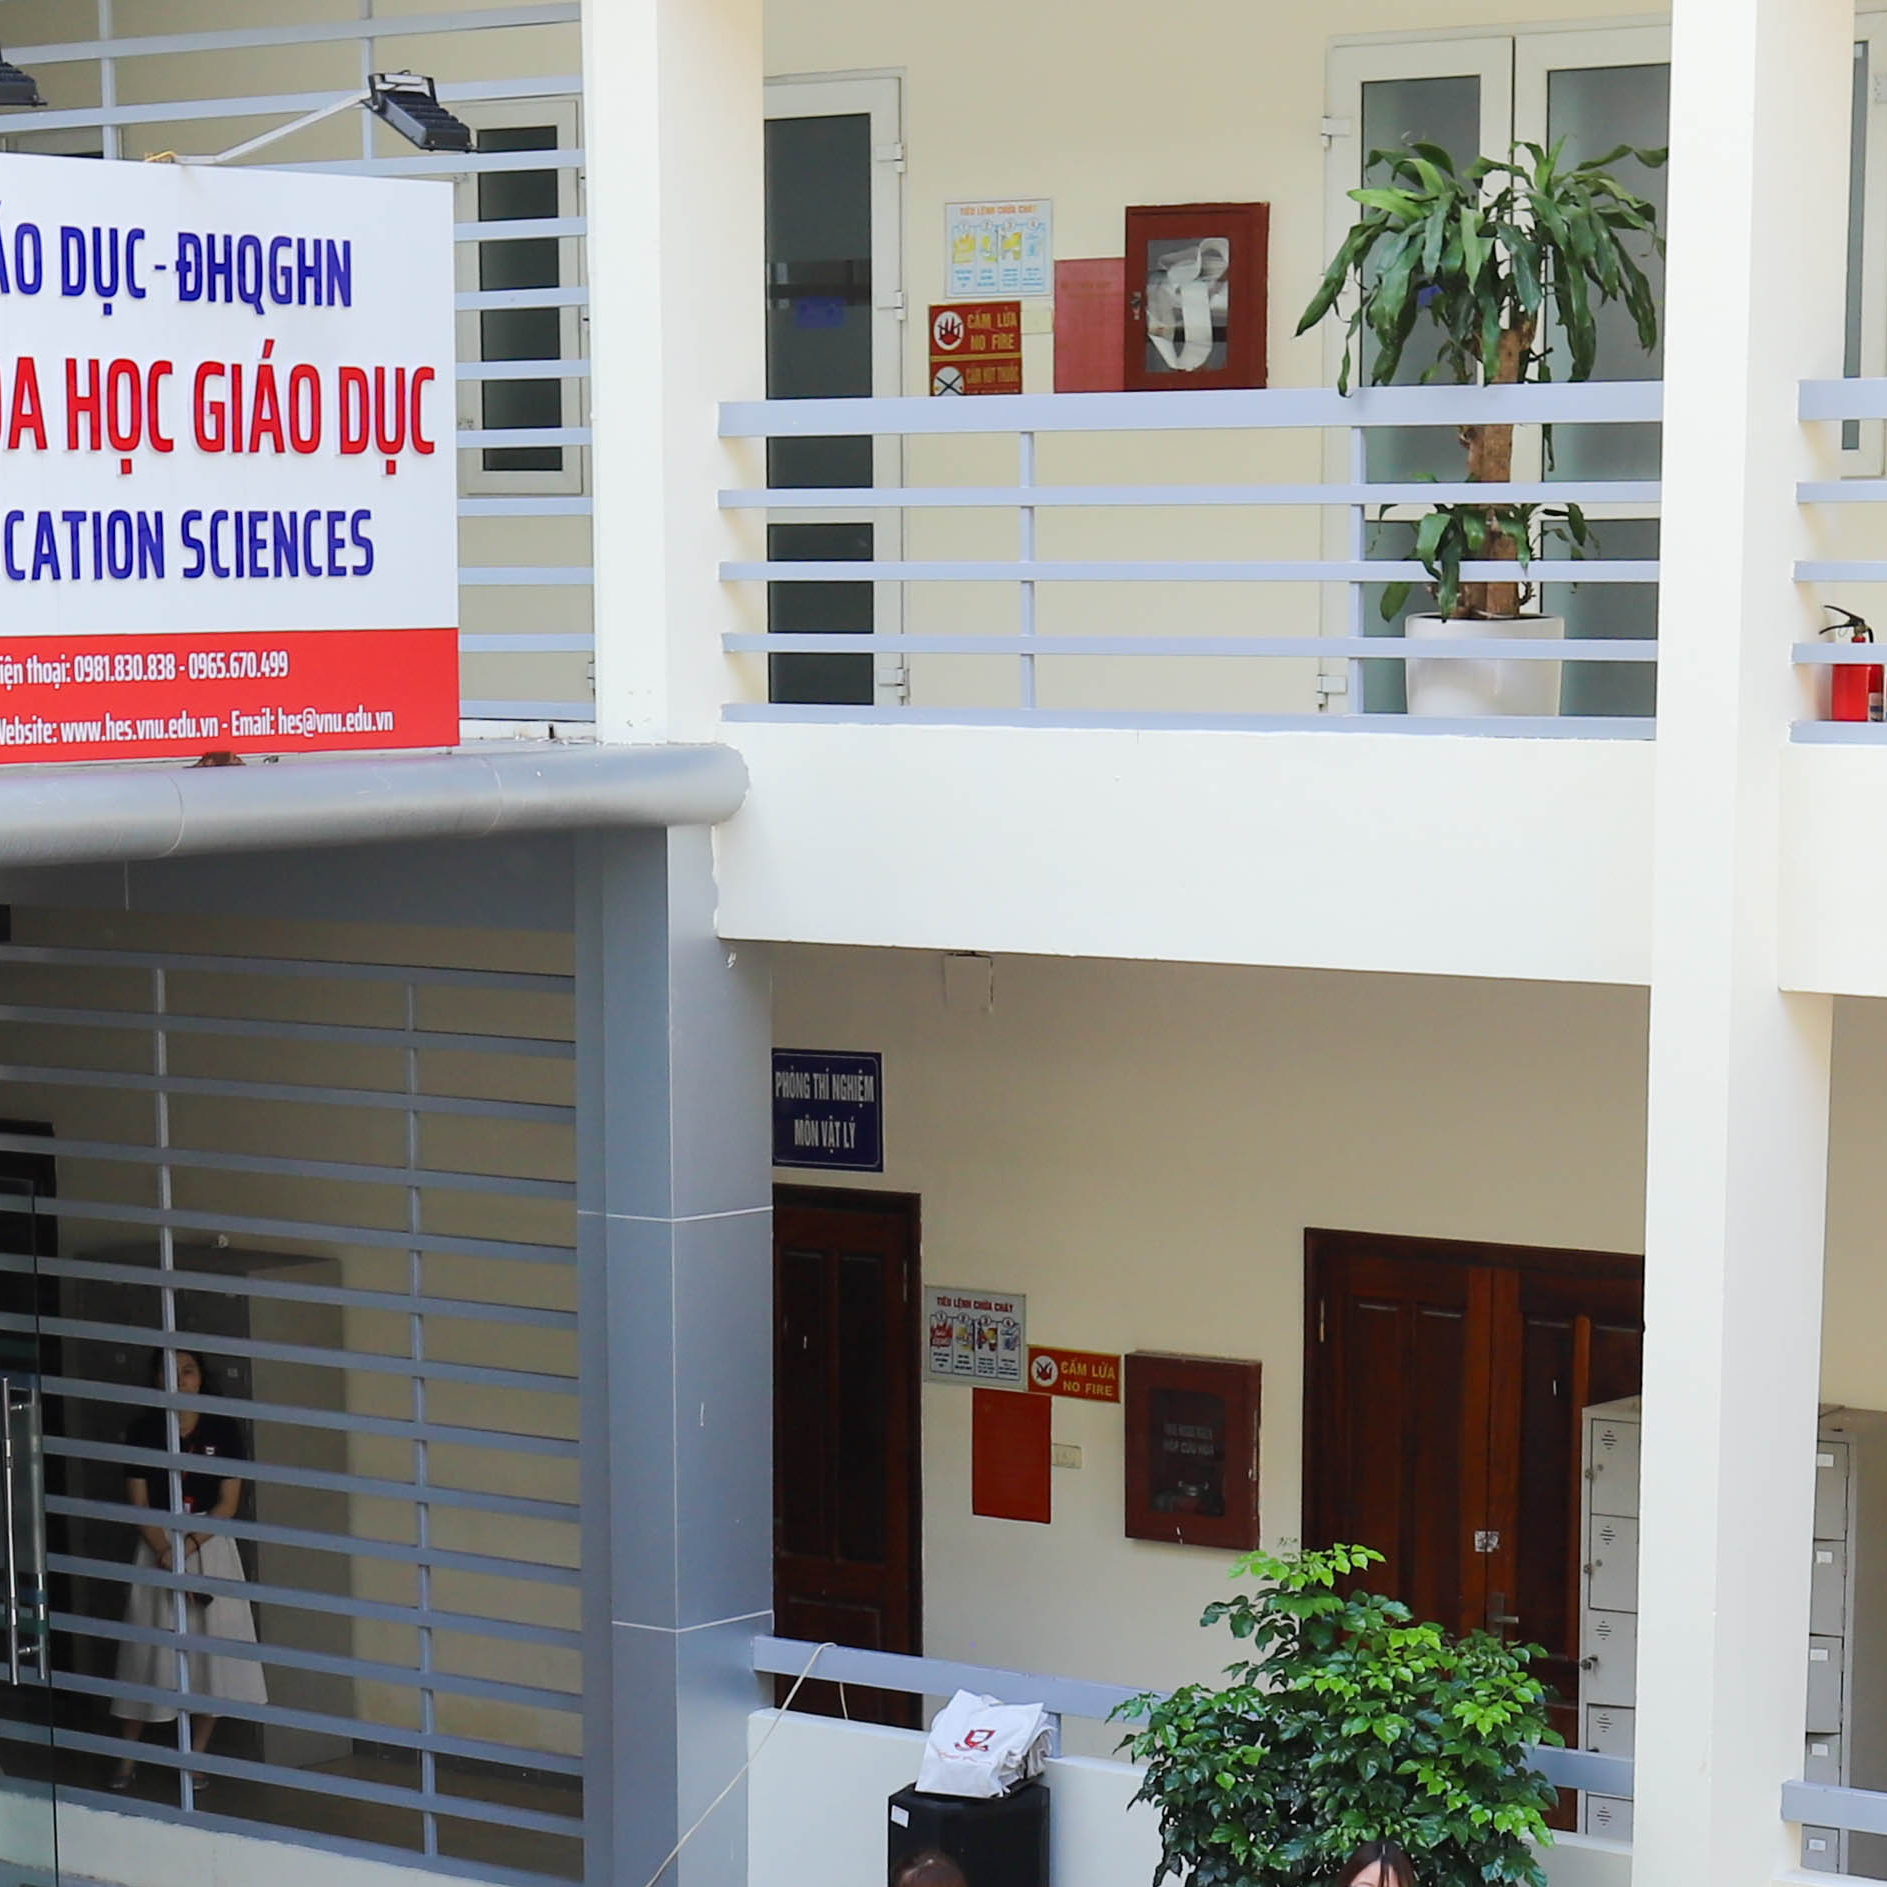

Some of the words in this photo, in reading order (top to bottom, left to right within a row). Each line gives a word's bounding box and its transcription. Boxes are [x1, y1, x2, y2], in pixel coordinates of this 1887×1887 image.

[61, 225, 146, 316] DỤC
[176, 231, 352, 315] ĐHQGHN
[970, 335, 986, 350] NO
[992, 334, 1015, 350] FIRE
[65, 357, 175, 476] HỌC
[193, 338, 322, 455] GIÁO
[338, 365, 436, 476] DỤC
[180, 508, 374, 580] SCIENCES
[26, 654, 71, 689] thoại:
[74, 653, 176, 683] 0981.830.838
[188, 651, 289, 680] 0965.670.499
[60, 711, 219, 742] www.hes.vnu.edu.vn
[231, 707, 275, 737] Email:
[278, 705, 394, 738] hes@vnu.edu.vn
[775, 1067, 810, 1100] PHÒNG
[813, 1067, 830, 1100] THÍ
[832, 1069, 874, 1108] NGHIỆM
[794, 1113, 818, 1147] MÔN
[822, 1115, 841, 1153] VẬT
[843, 1115, 855, 1149] LÝ
[1061, 1359, 1089, 1377] CẤM
[1062, 1380, 1081, 1394] NO
[1086, 1383, 1113, 1397] FIRE
